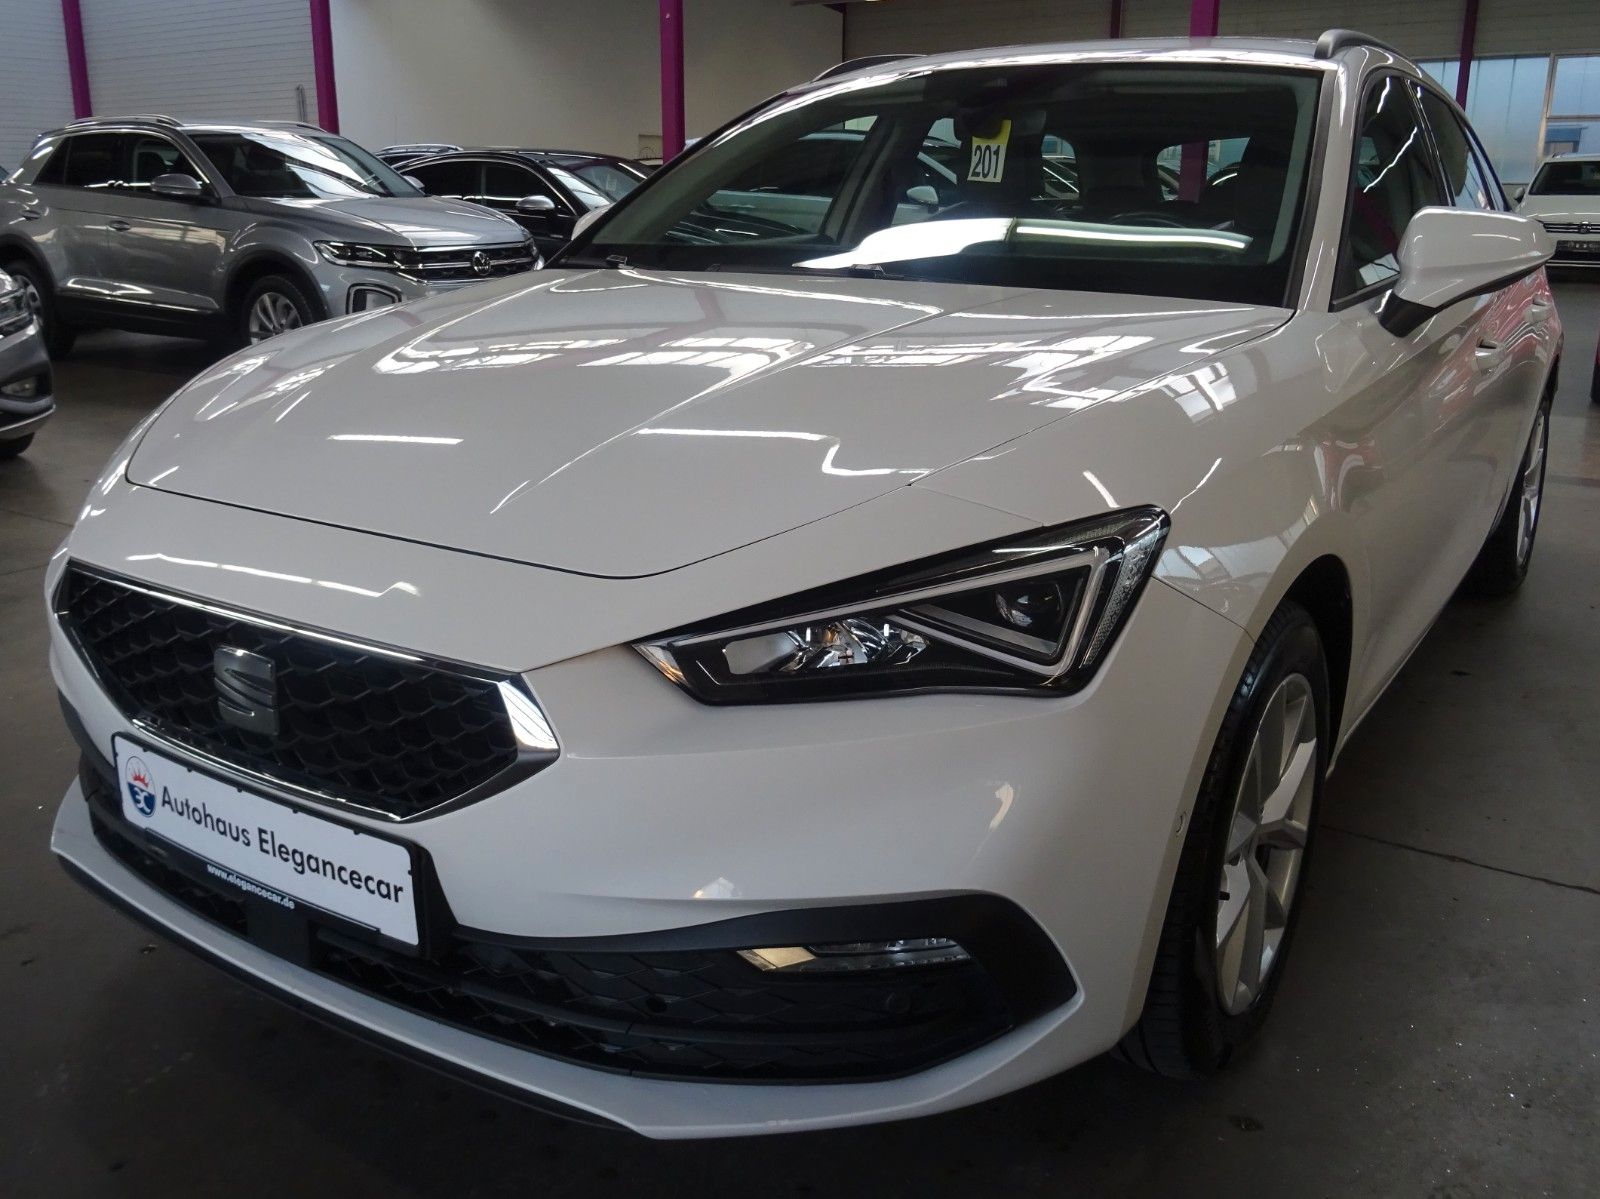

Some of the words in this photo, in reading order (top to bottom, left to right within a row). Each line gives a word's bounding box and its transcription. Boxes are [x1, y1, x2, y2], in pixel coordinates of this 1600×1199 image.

[971, 145, 1000, 178] 201
[162, 787, 251, 847] Autohaus
[258, 828, 403, 903] Elegancecar
[206, 864, 295, 909] www.elegancecar.de
